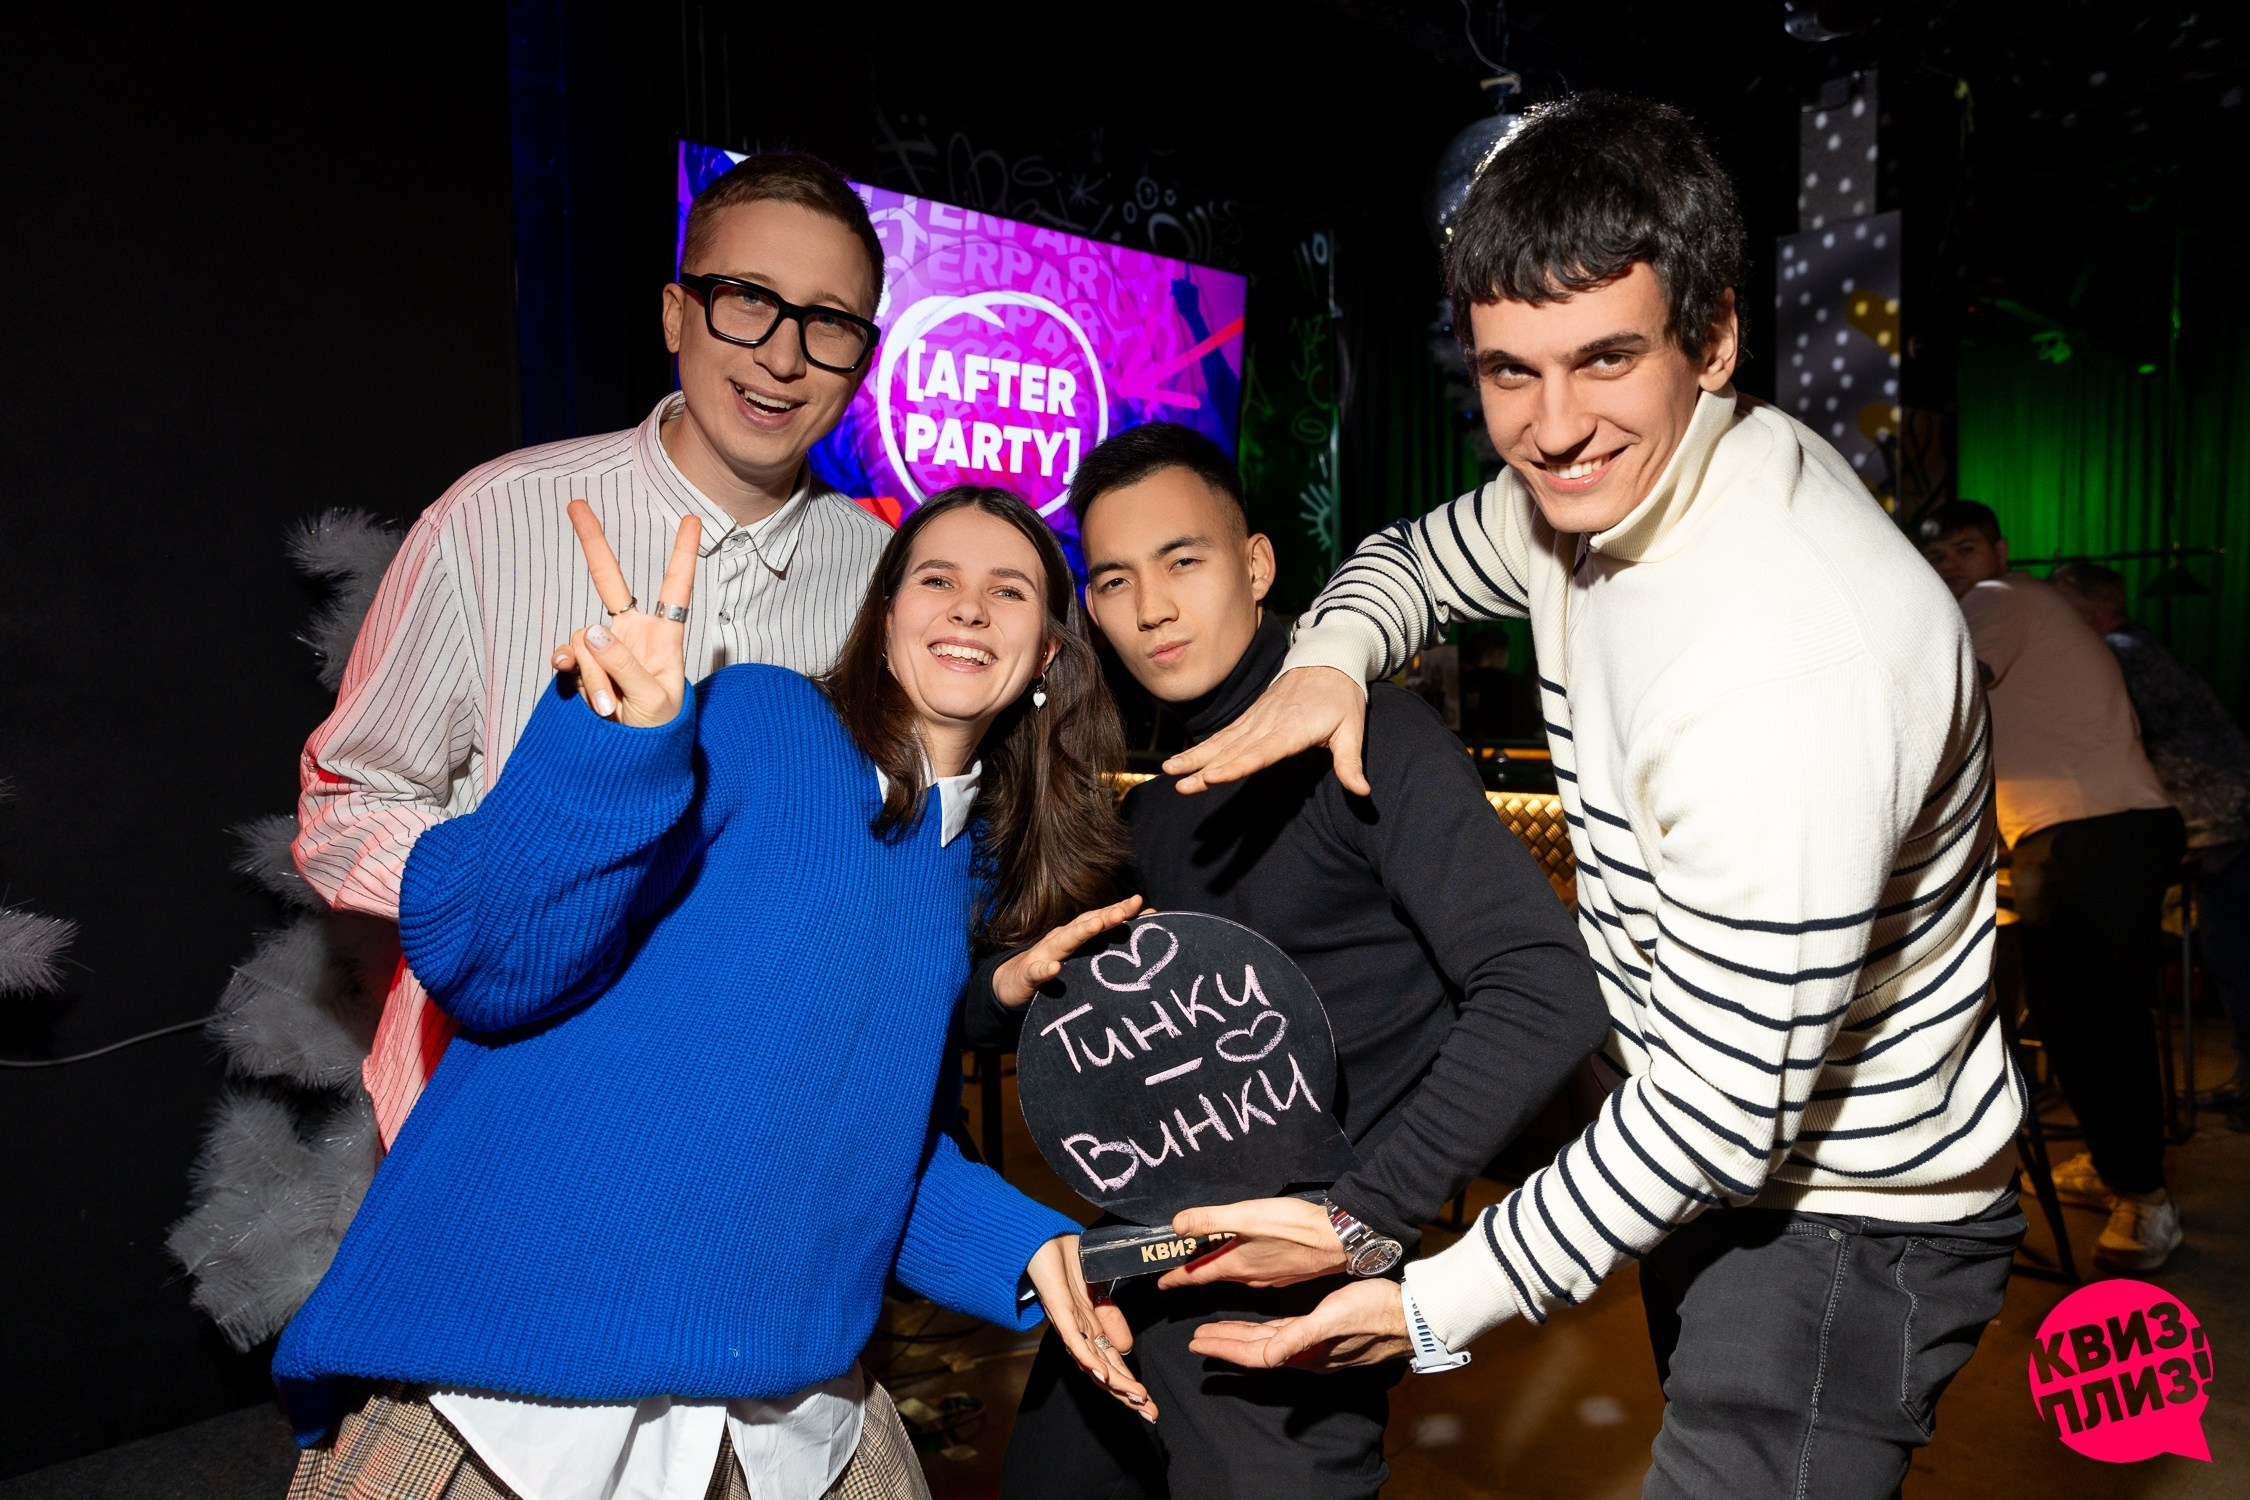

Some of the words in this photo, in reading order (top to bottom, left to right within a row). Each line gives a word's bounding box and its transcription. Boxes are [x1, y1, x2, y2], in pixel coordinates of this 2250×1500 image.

[906, 339, 1077, 417] [AFTER
[905, 412, 1081, 486] PARTY]
[1040, 963, 1272, 1073] Тинки
[1060, 1053, 1322, 1193] Винки
